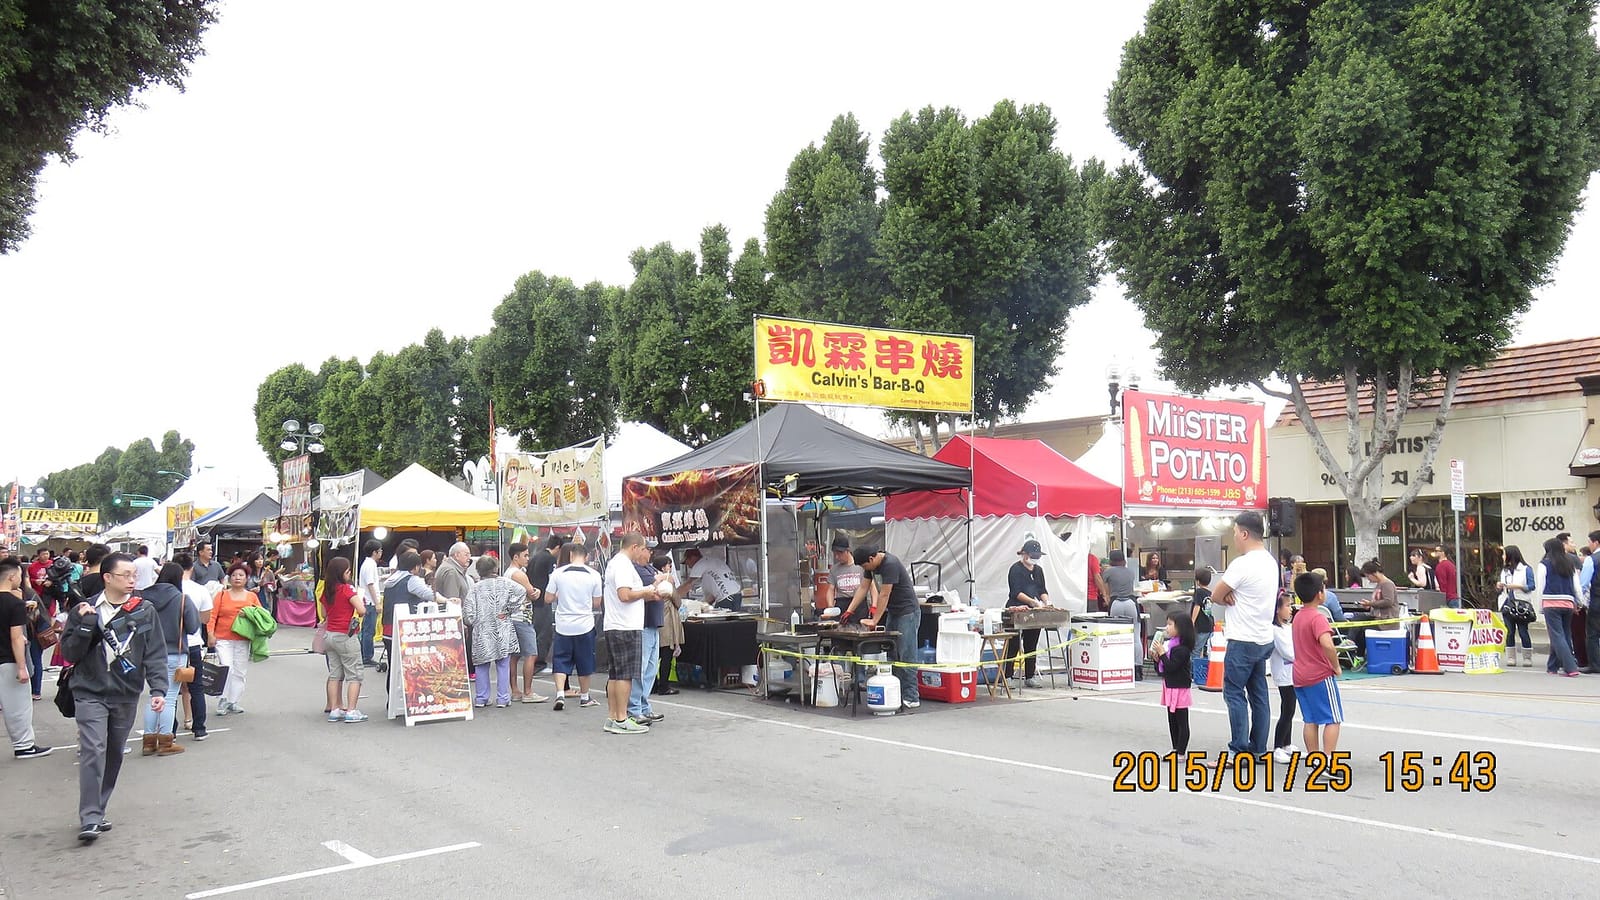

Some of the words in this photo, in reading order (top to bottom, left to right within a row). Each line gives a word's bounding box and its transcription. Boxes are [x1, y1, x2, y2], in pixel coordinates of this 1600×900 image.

[768, 325, 963, 379] 凱霖串燒
[811, 371, 869, 389] Calvin's
[873, 376, 926, 393] Bar-B-Q
[1146, 399, 1249, 444] MiiSTER
[1149, 440, 1247, 483] POTATO
[1156, 485, 1177, 495] Phone:
[1177, 486, 1194, 497] (213)
[1222, 488, 1241, 499] J&S
[1519, 497, 1568, 508] DENTISTRY
[1504, 515, 1565, 532] 287-6688
